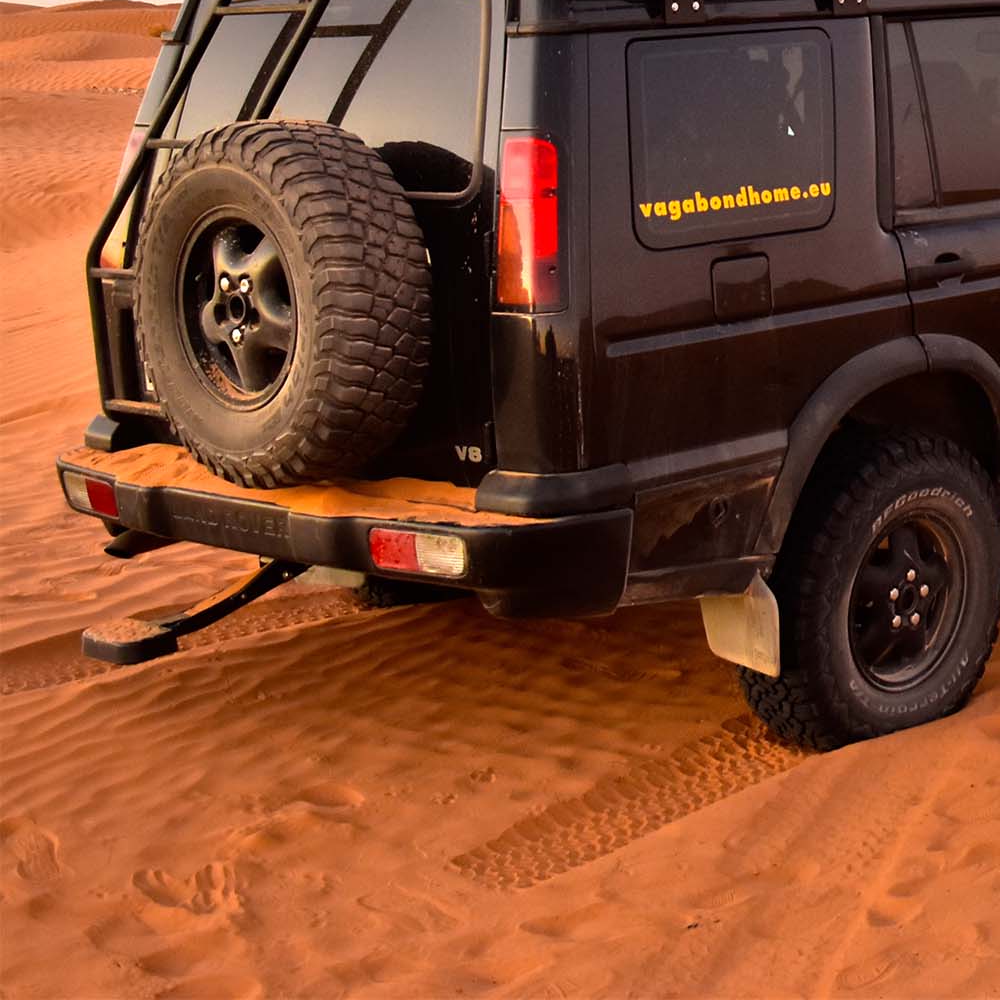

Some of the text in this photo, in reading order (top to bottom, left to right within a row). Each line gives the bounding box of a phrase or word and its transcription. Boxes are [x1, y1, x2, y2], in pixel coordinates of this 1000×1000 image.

[639, 180, 832, 221] vagabondhome.eu
[454, 445, 482, 463] V8
[871, 486, 974, 535] BFGoodrich
